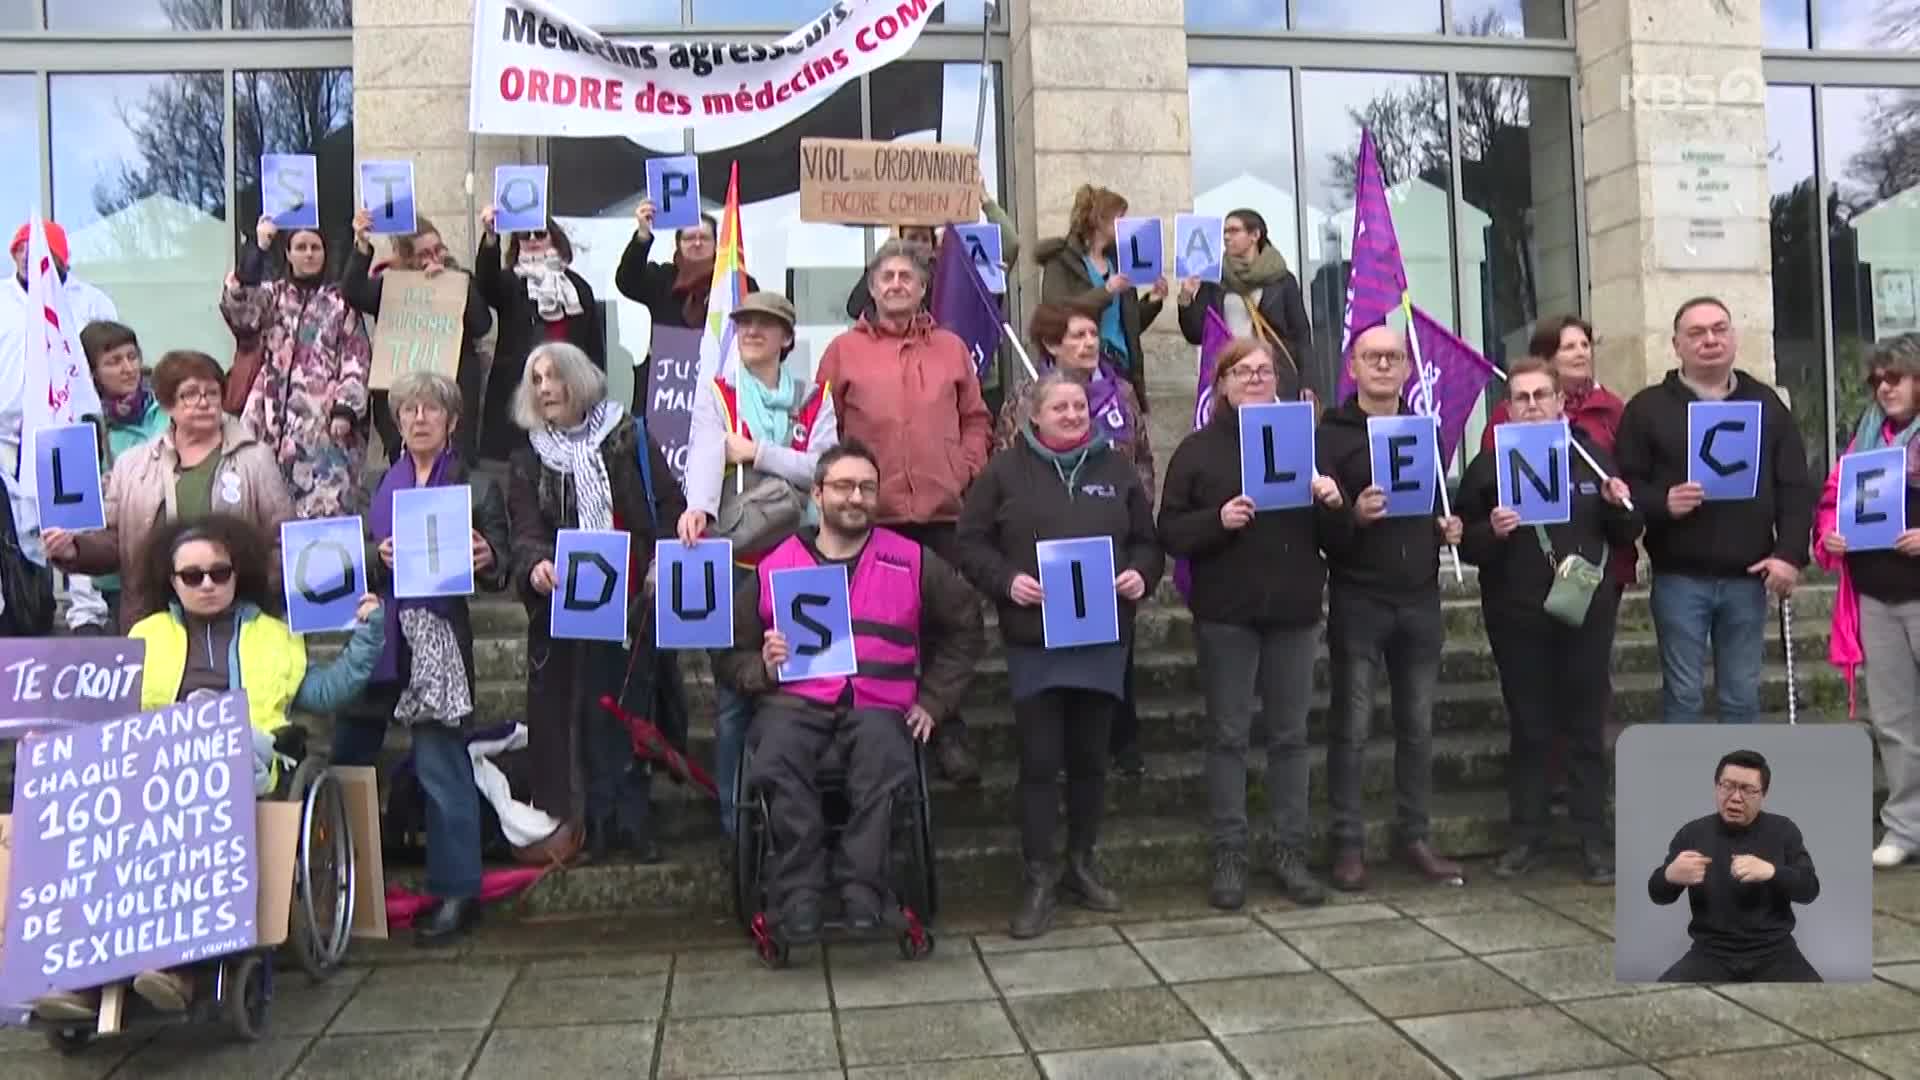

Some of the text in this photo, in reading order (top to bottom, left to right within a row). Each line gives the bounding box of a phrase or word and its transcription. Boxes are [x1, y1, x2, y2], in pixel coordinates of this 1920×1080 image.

[500, 66, 623, 111] ORDRE
[635, 81, 692, 115] des
[702, 48, 849, 114] médecins
[278, 169, 305, 212] S
[662, 172, 688, 212] P
[803, 143, 850, 182] VIOL
[874, 147, 979, 185] ORDONNANCE
[371, 175, 406, 218] T
[500, 177, 539, 213] O
[821, 192, 880, 216] ENCORE
[888, 193, 949, 216] COMBIEN
[1130, 233, 1152, 269] L
[1185, 227, 1214, 263] A
[52, 448, 83, 504] L
[1262, 424, 1296, 483] L
[1388, 435, 1420, 492] E
[1509, 447, 1559, 505] N
[1699, 420, 1749, 476] C
[1855, 467, 1888, 525] E
[296, 538, 356, 602] O
[427, 513, 439, 573] I
[564, 551, 618, 611] D
[671, 560, 716, 621] U
[1071, 560, 1086, 618] I
[791, 593, 832, 656] S
[5, 657, 47, 701] TE
[32, 696, 236, 766] EN FRANCE
[23, 727, 243, 798] CHAQUE ANNÉE
[38, 786, 122, 840] 160
[142, 761, 230, 812] 000
[67, 800, 233, 869] ENFANTS
[18, 871, 97, 909] SONT
[22, 908, 62, 941] DE
[41, 901, 252, 974] SEXUELLES.
